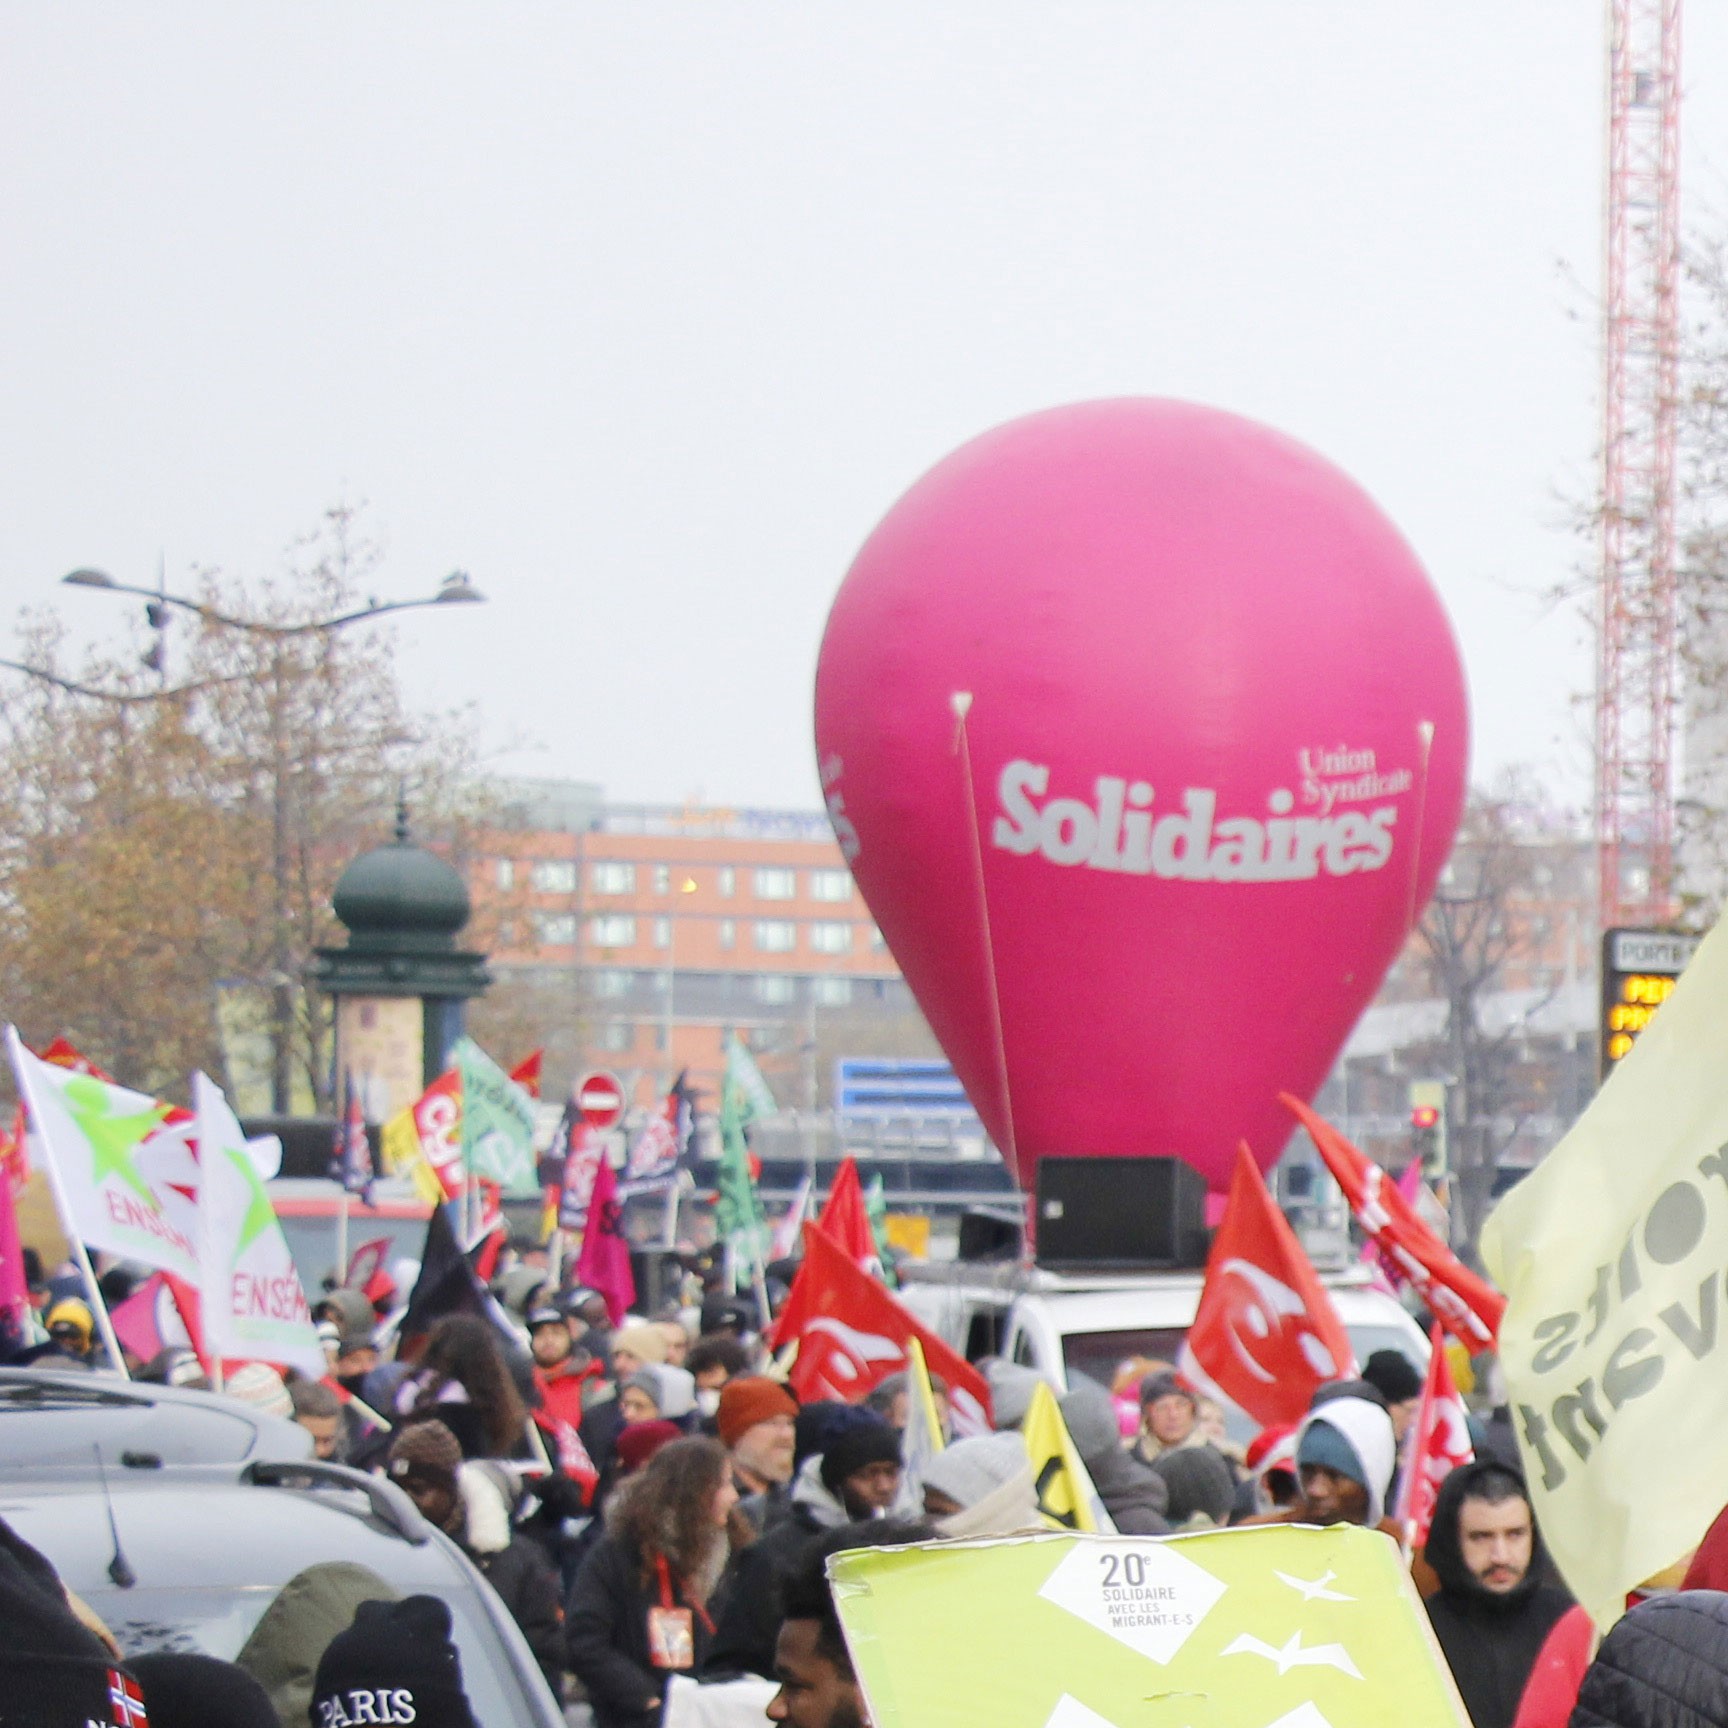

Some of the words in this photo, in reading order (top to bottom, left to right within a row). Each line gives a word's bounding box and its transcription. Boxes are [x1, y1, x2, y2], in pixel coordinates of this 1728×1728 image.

[1300, 745, 1376, 774] Union
[992, 759, 1398, 882] Solidaires
[1102, 1587, 1177, 1602] SOLIDAIRE
[1108, 1603, 1137, 1615] AVEC
[1140, 1602, 1161, 1613] LES
[1112, 1614, 1194, 1628] MIGRANT-E-S
